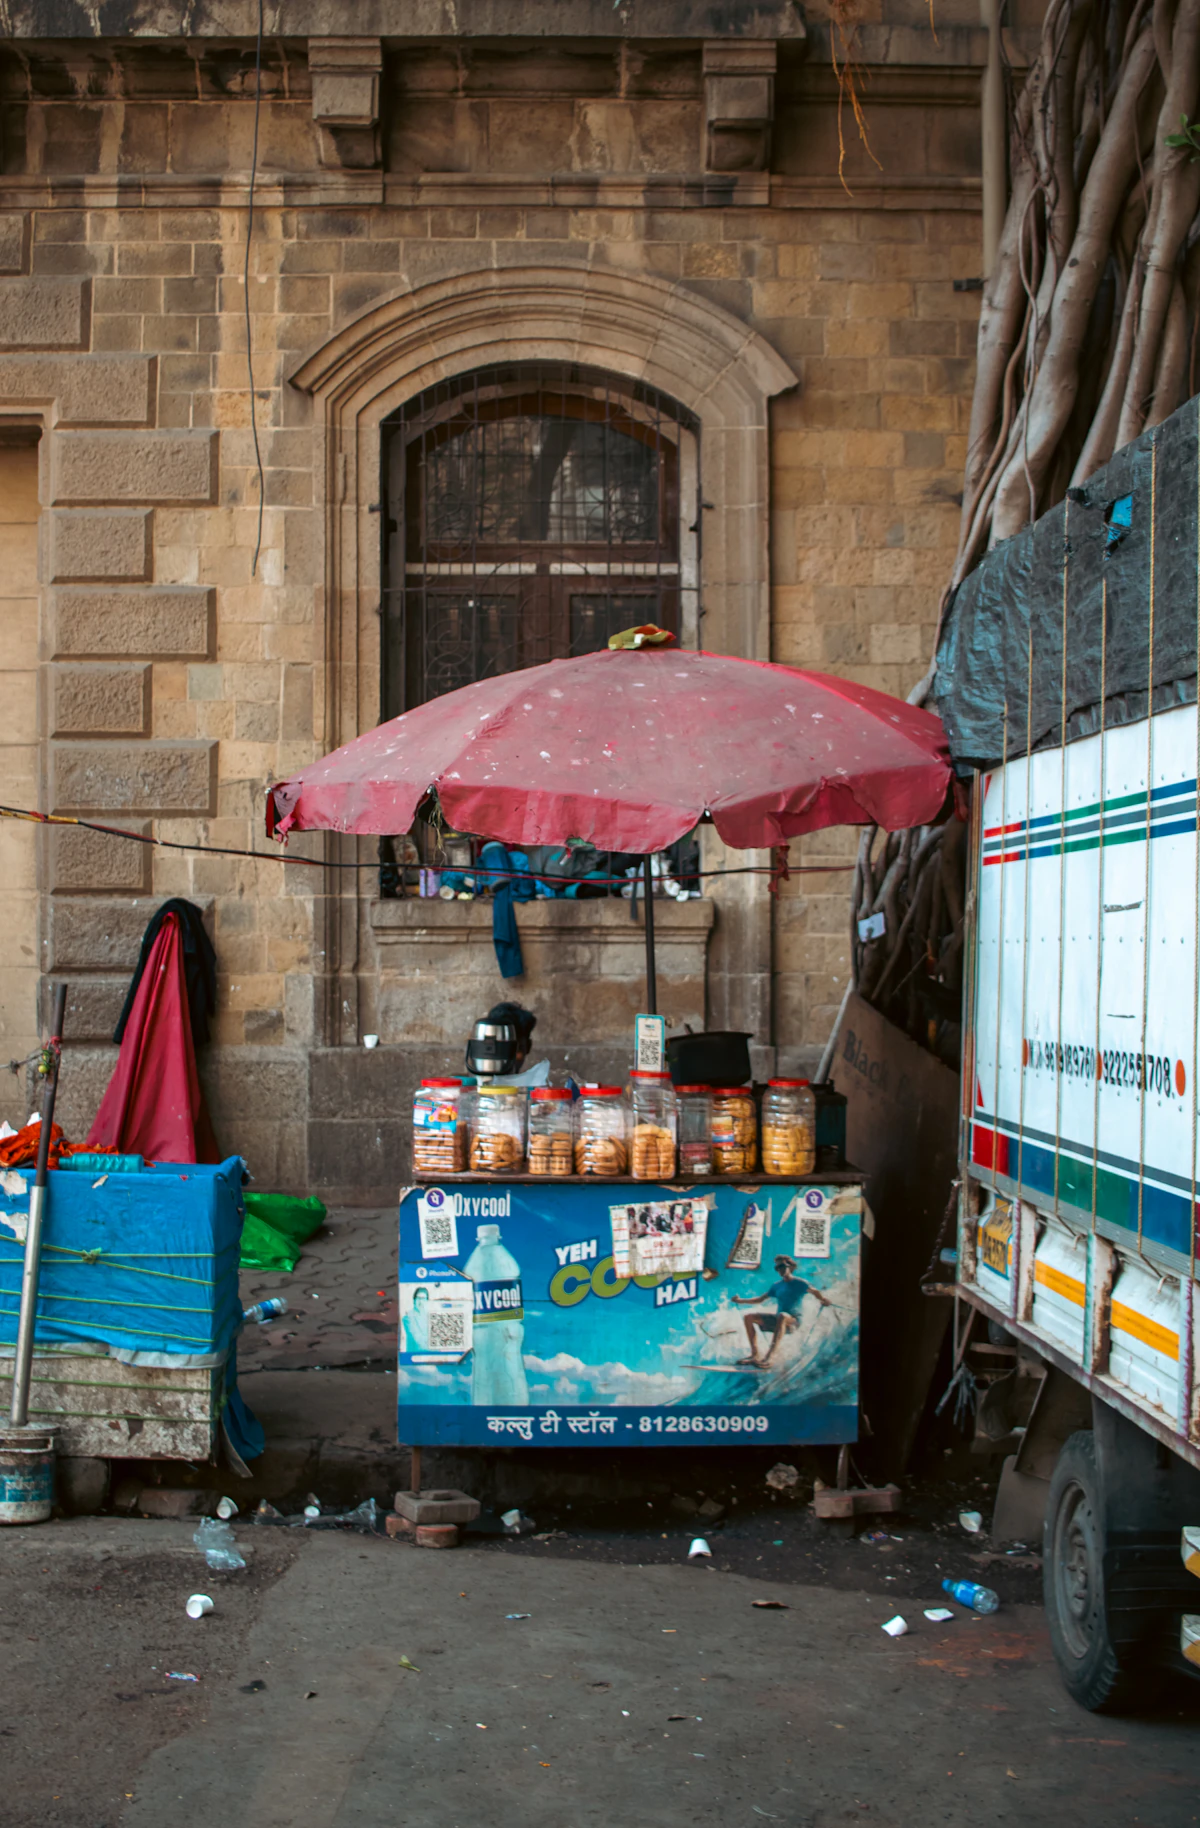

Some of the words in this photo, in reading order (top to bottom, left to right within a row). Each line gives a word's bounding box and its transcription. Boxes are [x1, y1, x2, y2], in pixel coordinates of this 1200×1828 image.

[555, 1239, 597, 1266] YEH
[550, 1256, 697, 1306] CO
[656, 1279, 697, 1306] HAI
[539, 1410, 562, 1433] टी
[567, 1411, 618, 1433] स्टॉल
[639, 1416, 769, 1433] 8128630909
